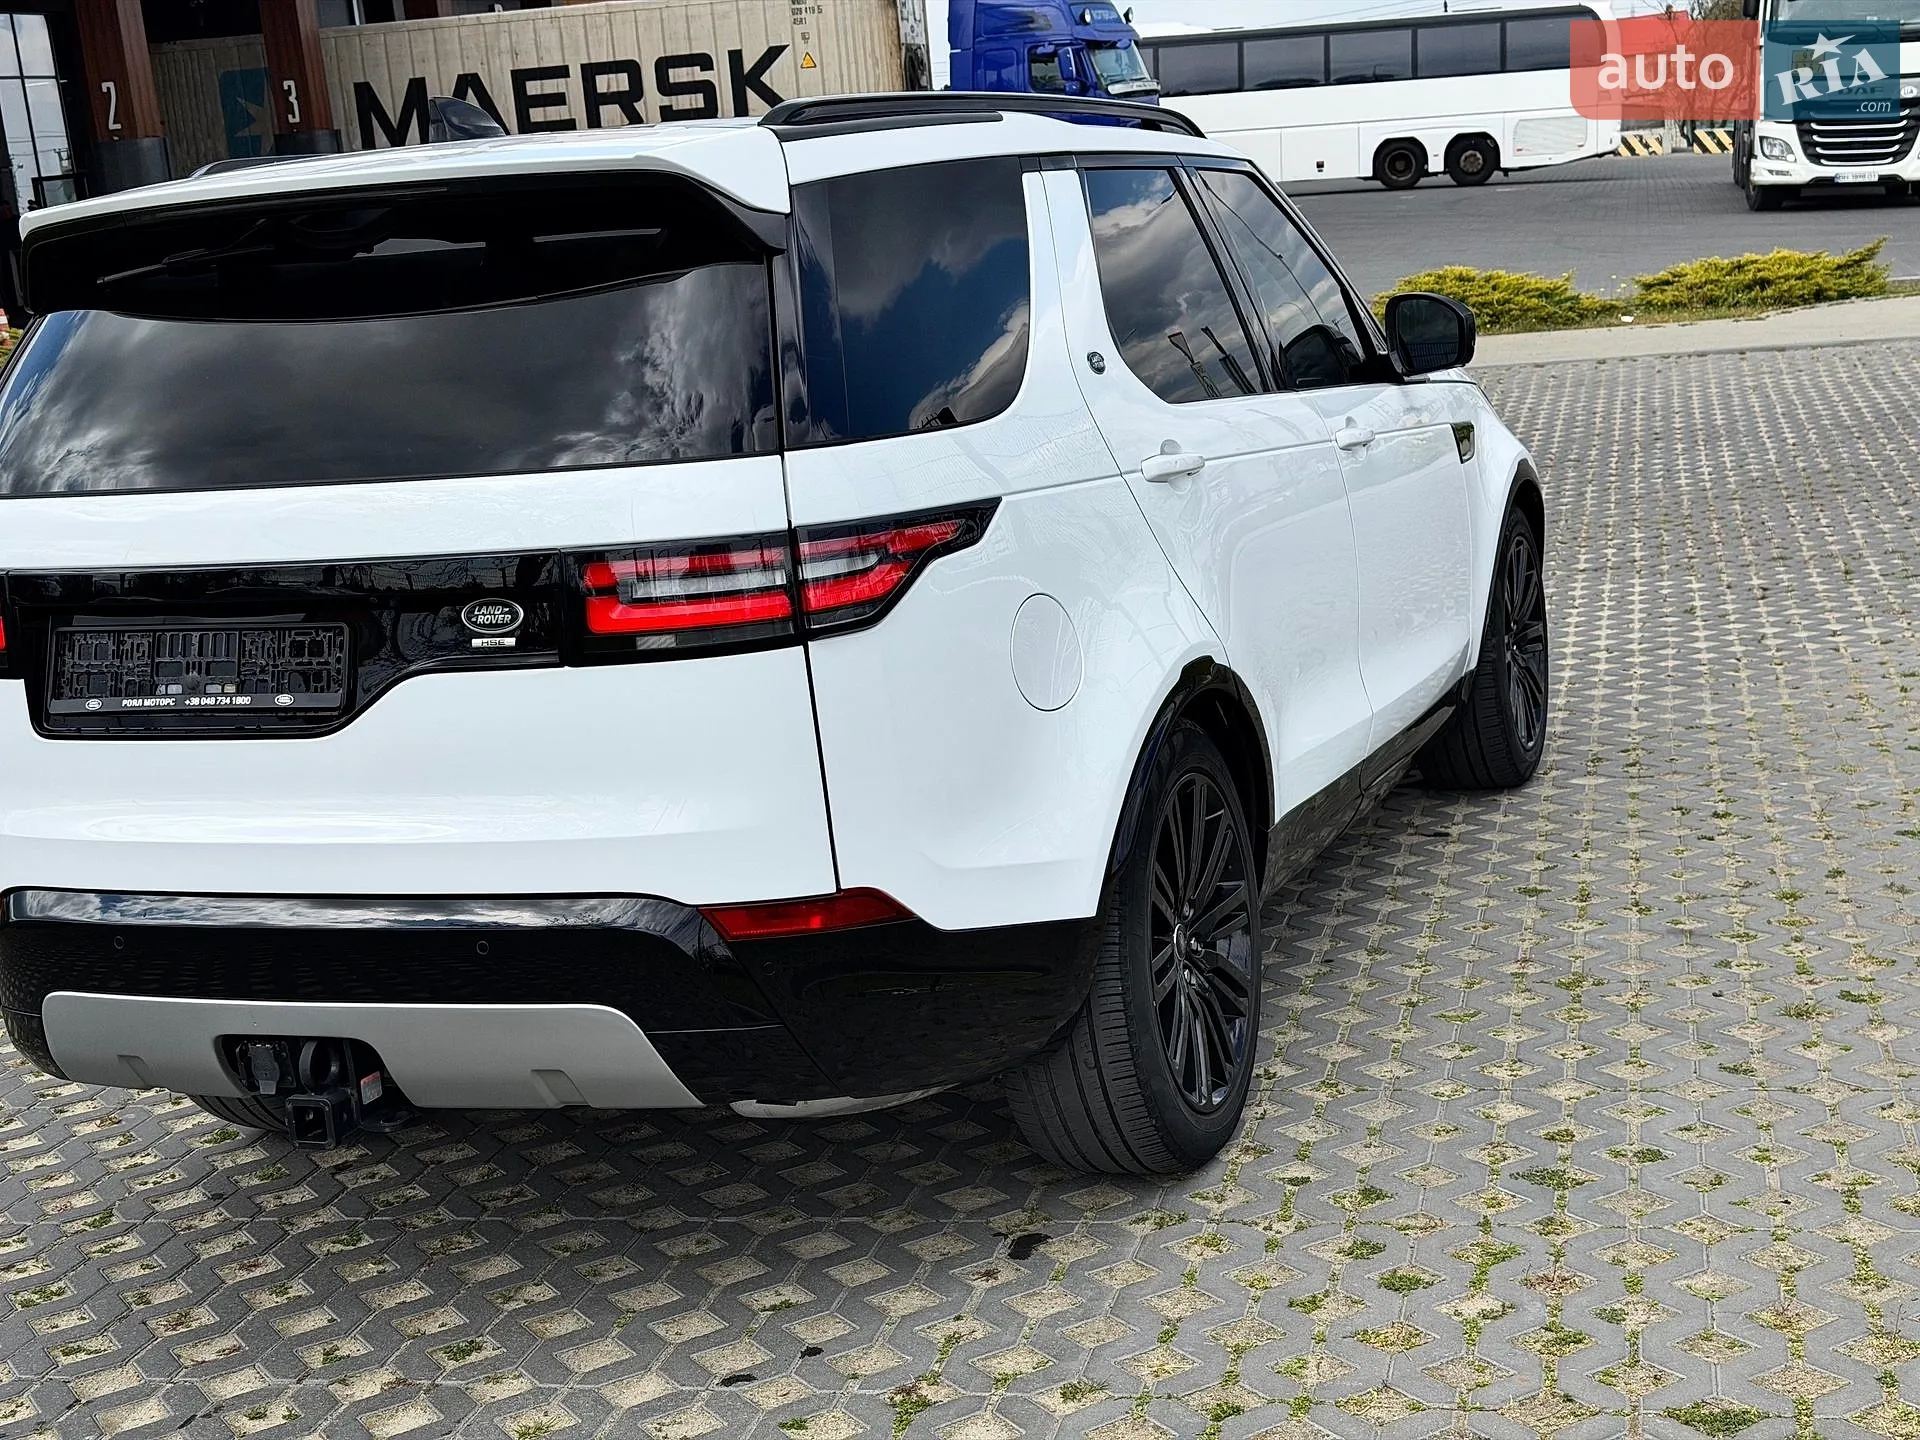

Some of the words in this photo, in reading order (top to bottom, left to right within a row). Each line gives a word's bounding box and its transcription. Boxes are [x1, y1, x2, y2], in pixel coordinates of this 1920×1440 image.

[283, 79, 300, 123] 3
[353, 44, 790, 149] MAERSK
[101, 81, 121, 130] 2
[474, 605, 503, 615] LAND
[476, 614, 512, 625] ROVER
[480, 639, 506, 647] HSE
[121, 698, 142, 707] РОЯЛ
[143, 697, 176, 707] МОТОРС
[184, 696, 200, 706] +38
[200, 696, 215, 705] 048
[216, 696, 231, 705] 734
[231, 696, 252, 705] 1800
